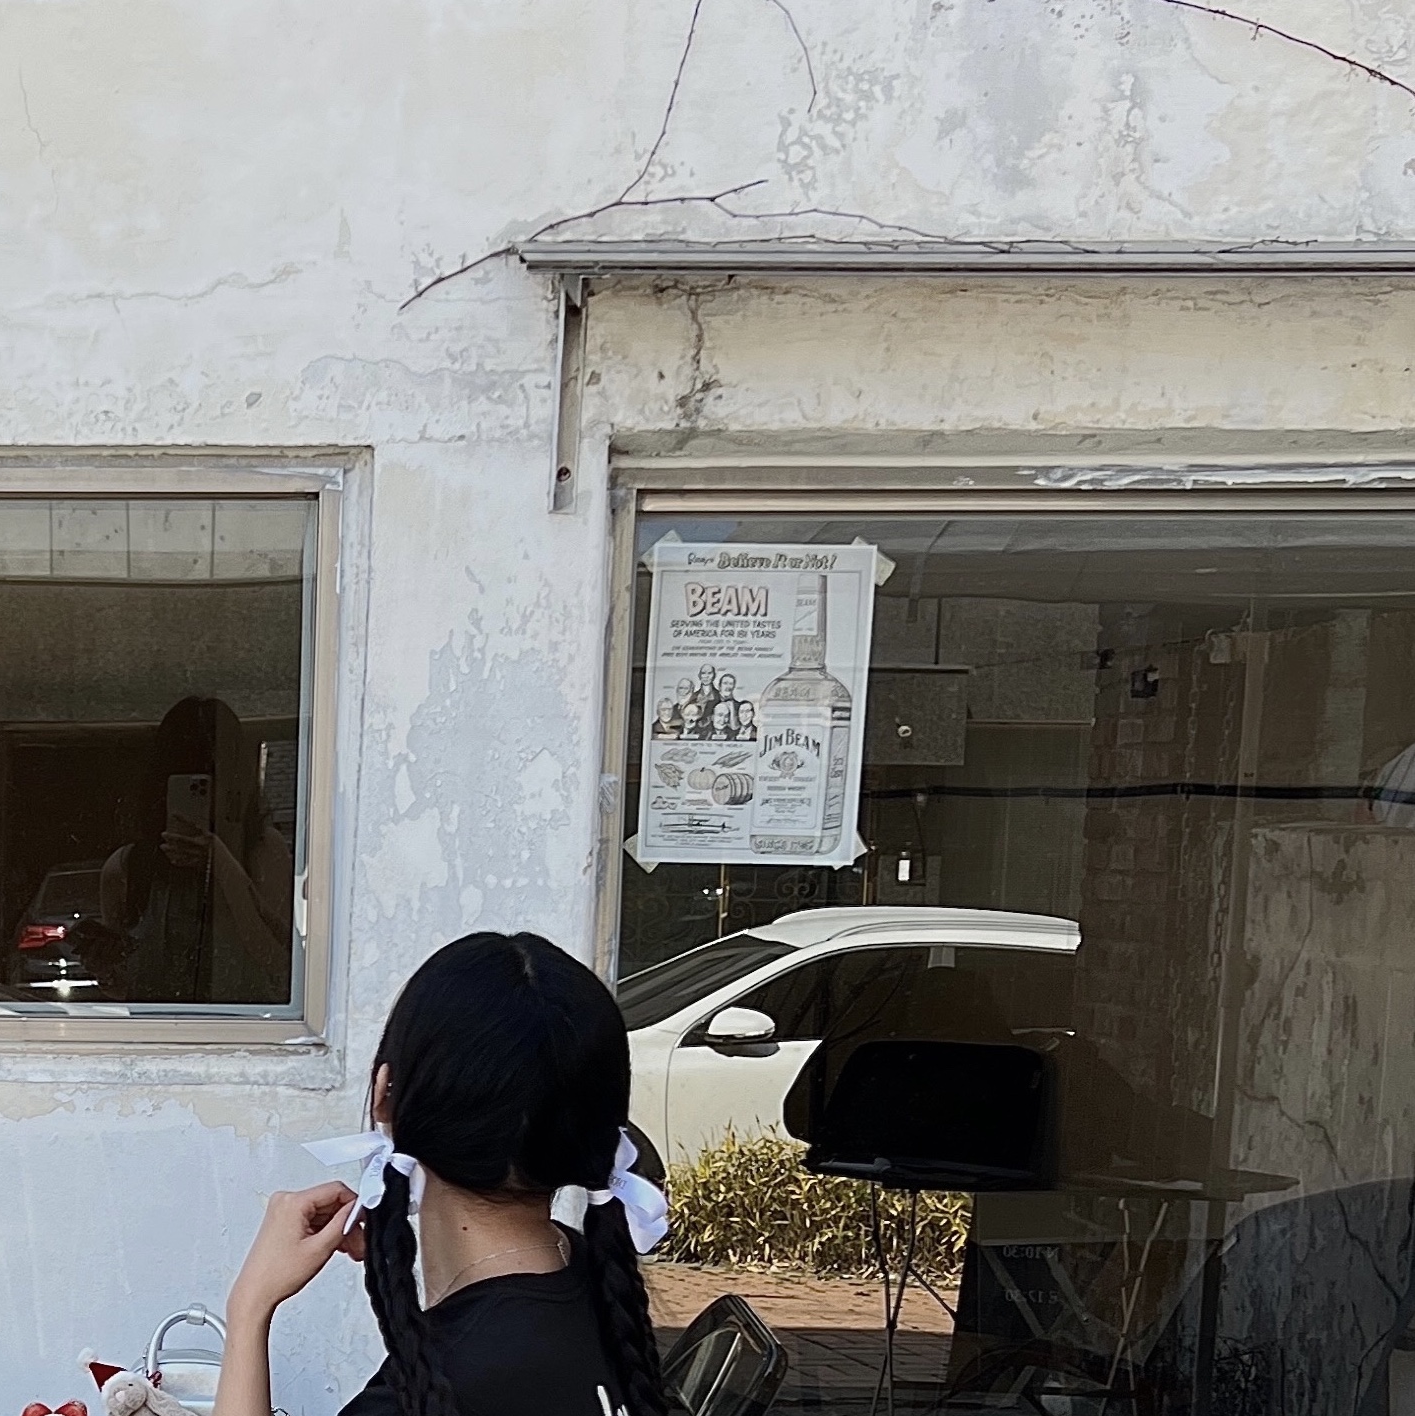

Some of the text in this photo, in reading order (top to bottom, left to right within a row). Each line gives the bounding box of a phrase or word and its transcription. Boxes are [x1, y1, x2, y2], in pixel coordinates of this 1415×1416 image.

[718, 552, 771, 569] Believe
[685, 582, 769, 617] BEAM
[670, 620, 781, 630] SERVING THE UNITED TASTES
[673, 629, 683, 638] OF
[684, 629, 718, 638] AMERICA
[720, 629, 735, 638] FOR
[750, 630, 777, 639] YEARS
[759, 728, 821, 758] JIM BEAM
